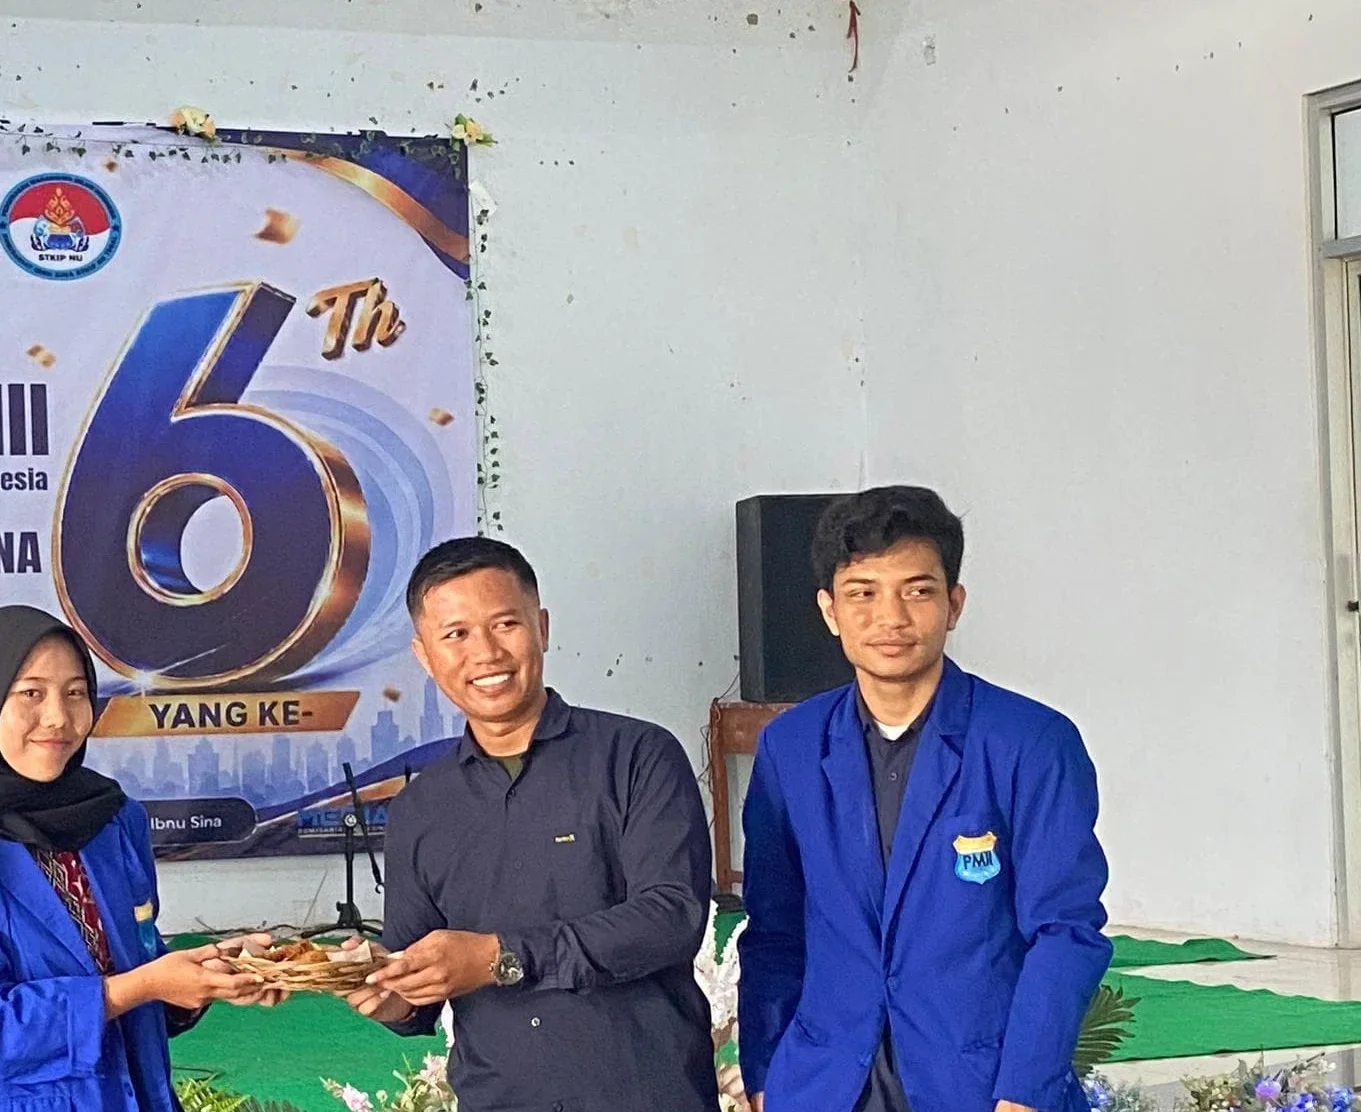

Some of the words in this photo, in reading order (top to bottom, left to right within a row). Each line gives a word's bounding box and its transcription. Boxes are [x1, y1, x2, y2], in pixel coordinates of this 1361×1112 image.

[38, 254, 66, 262] STKIP
[68, 254, 84, 262] NU
[306, 277, 407, 361] Th
[51, 281, 372, 690] 6
[149, 700, 248, 730] YANG
[257, 700, 314, 728] KE-
[150, 816, 186, 831] Ibnu
[189, 814, 223, 829] Sina
[963, 850, 994, 870] PMII
